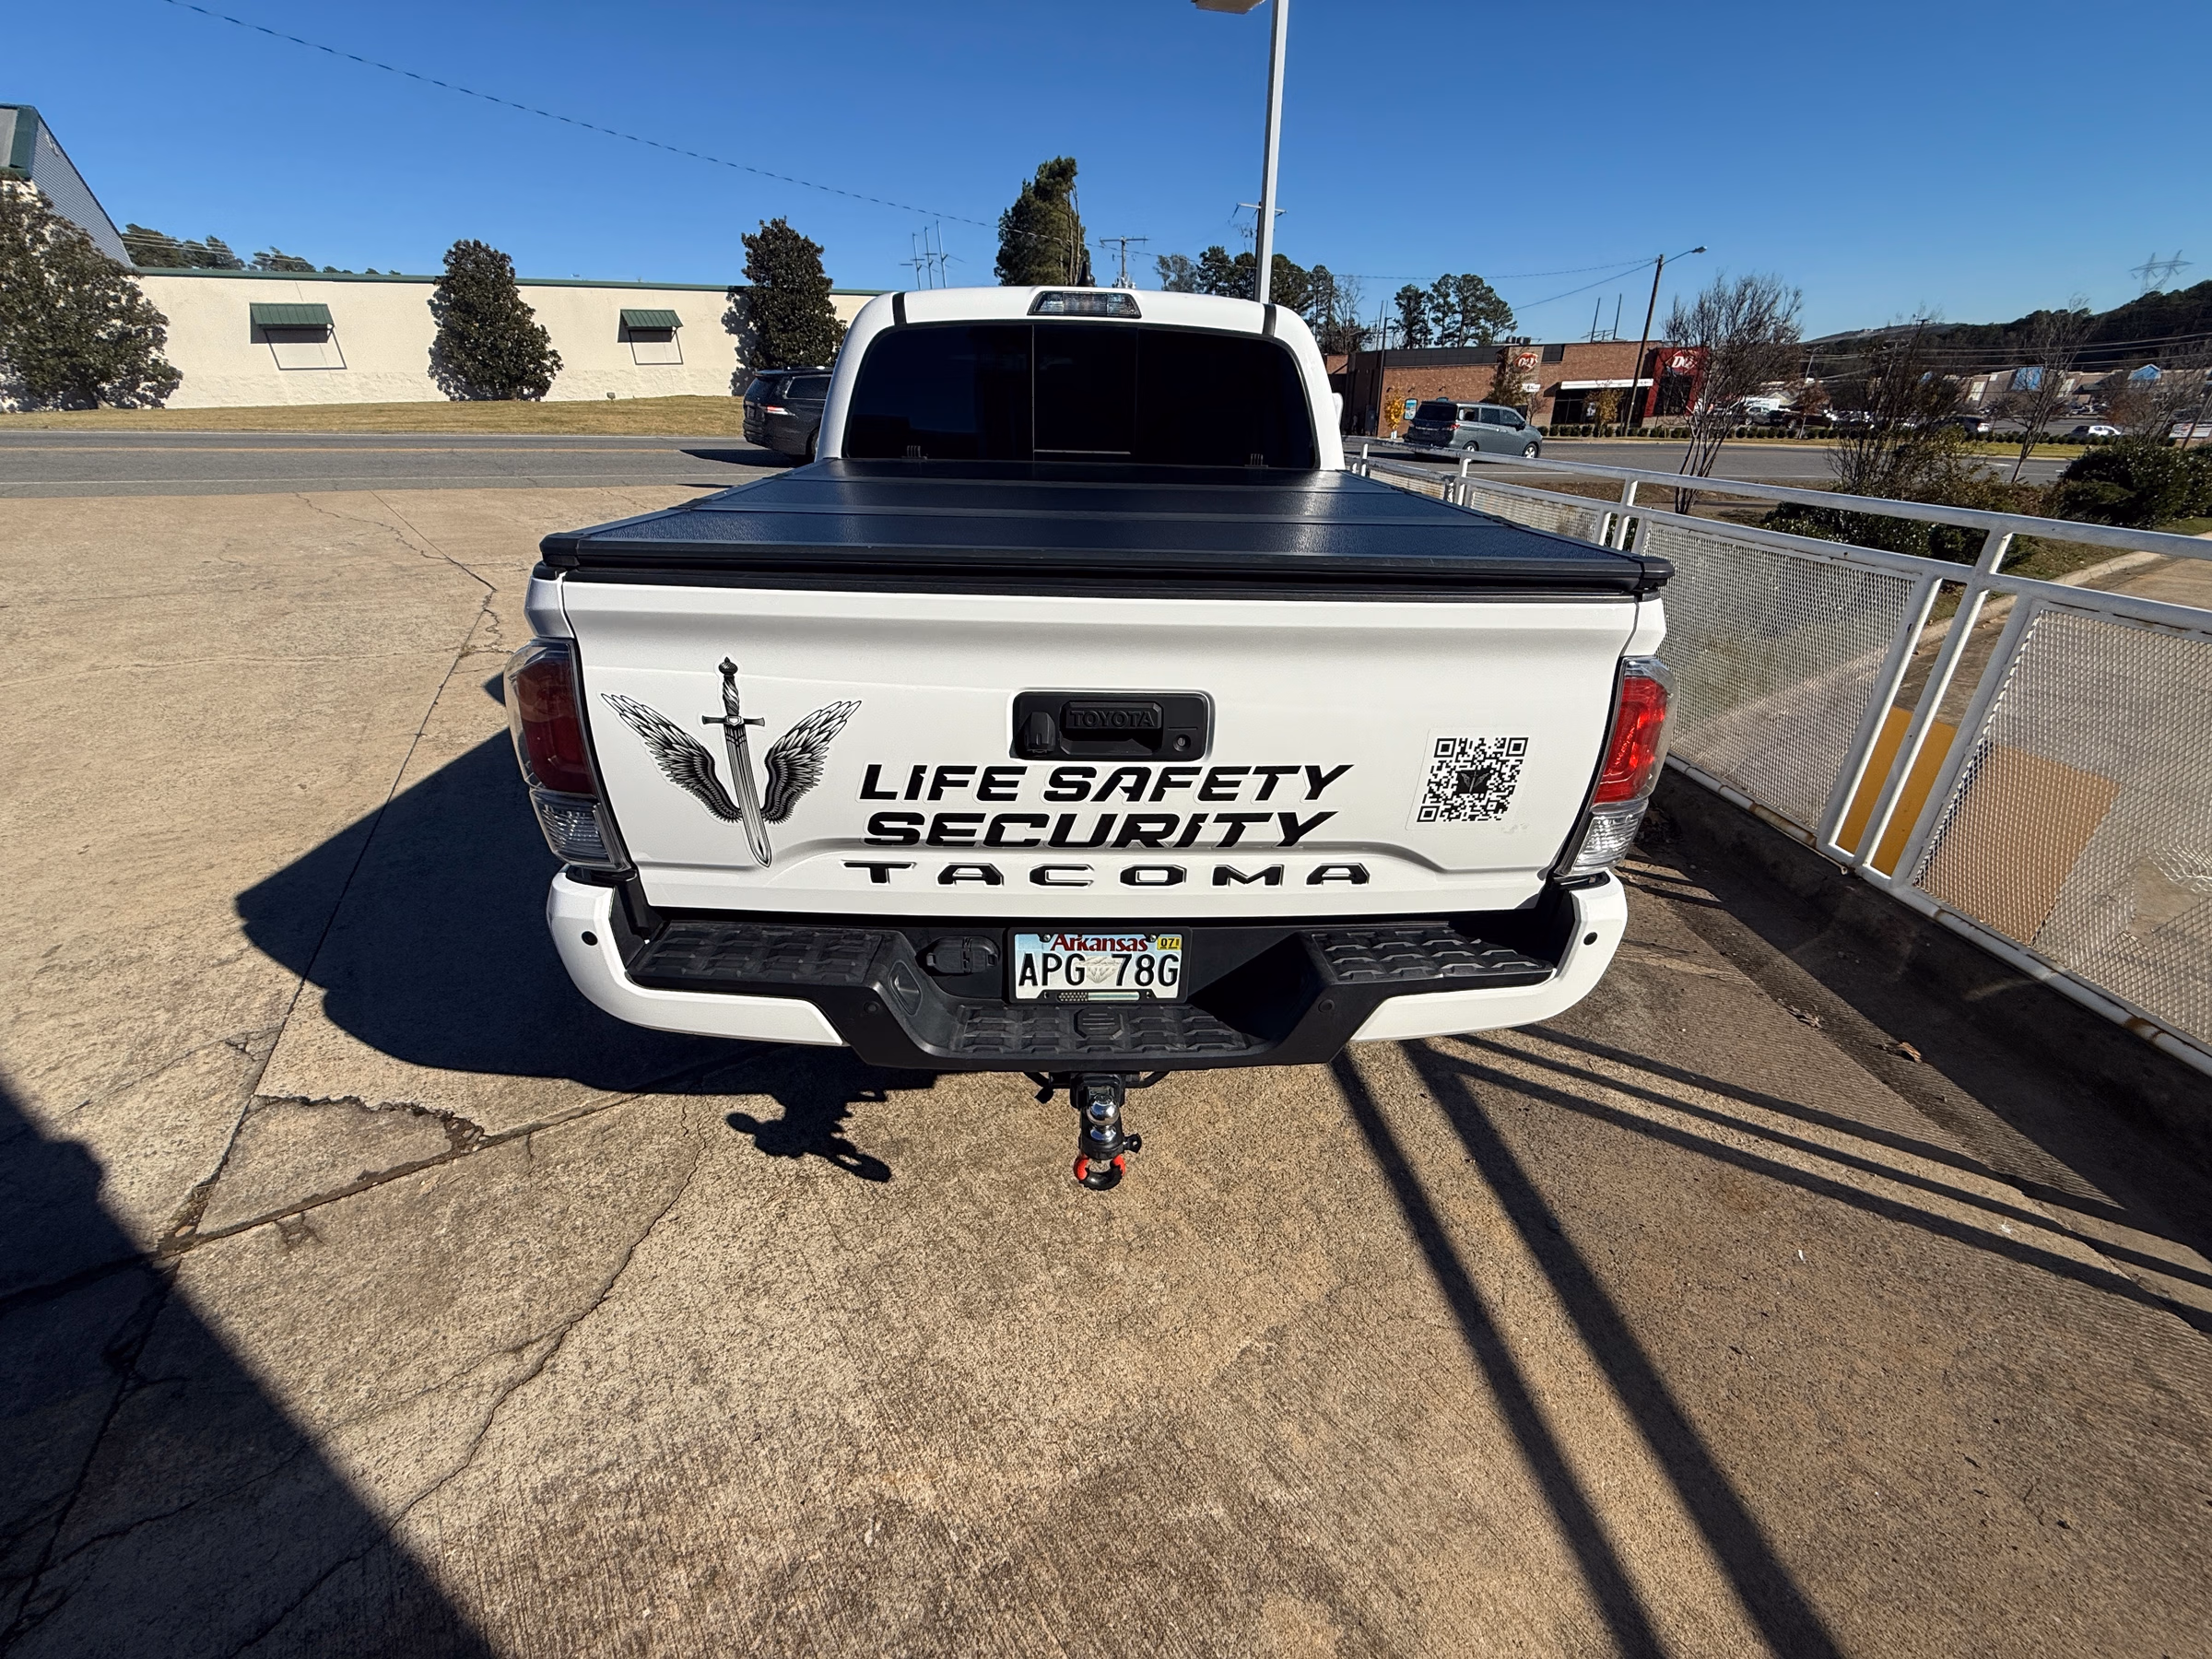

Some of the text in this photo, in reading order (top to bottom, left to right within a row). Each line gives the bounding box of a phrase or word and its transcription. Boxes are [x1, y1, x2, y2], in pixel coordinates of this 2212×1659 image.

[1070, 710, 1155, 728] TOYOTA
[859, 764, 1355, 802] LIFE SAFETY
[865, 810, 1339, 848] SECURITY
[841, 859, 1371, 887] TACOMA
[1050, 933, 1148, 952] Arkansas
[1018, 953, 1180, 987] APG 78G
